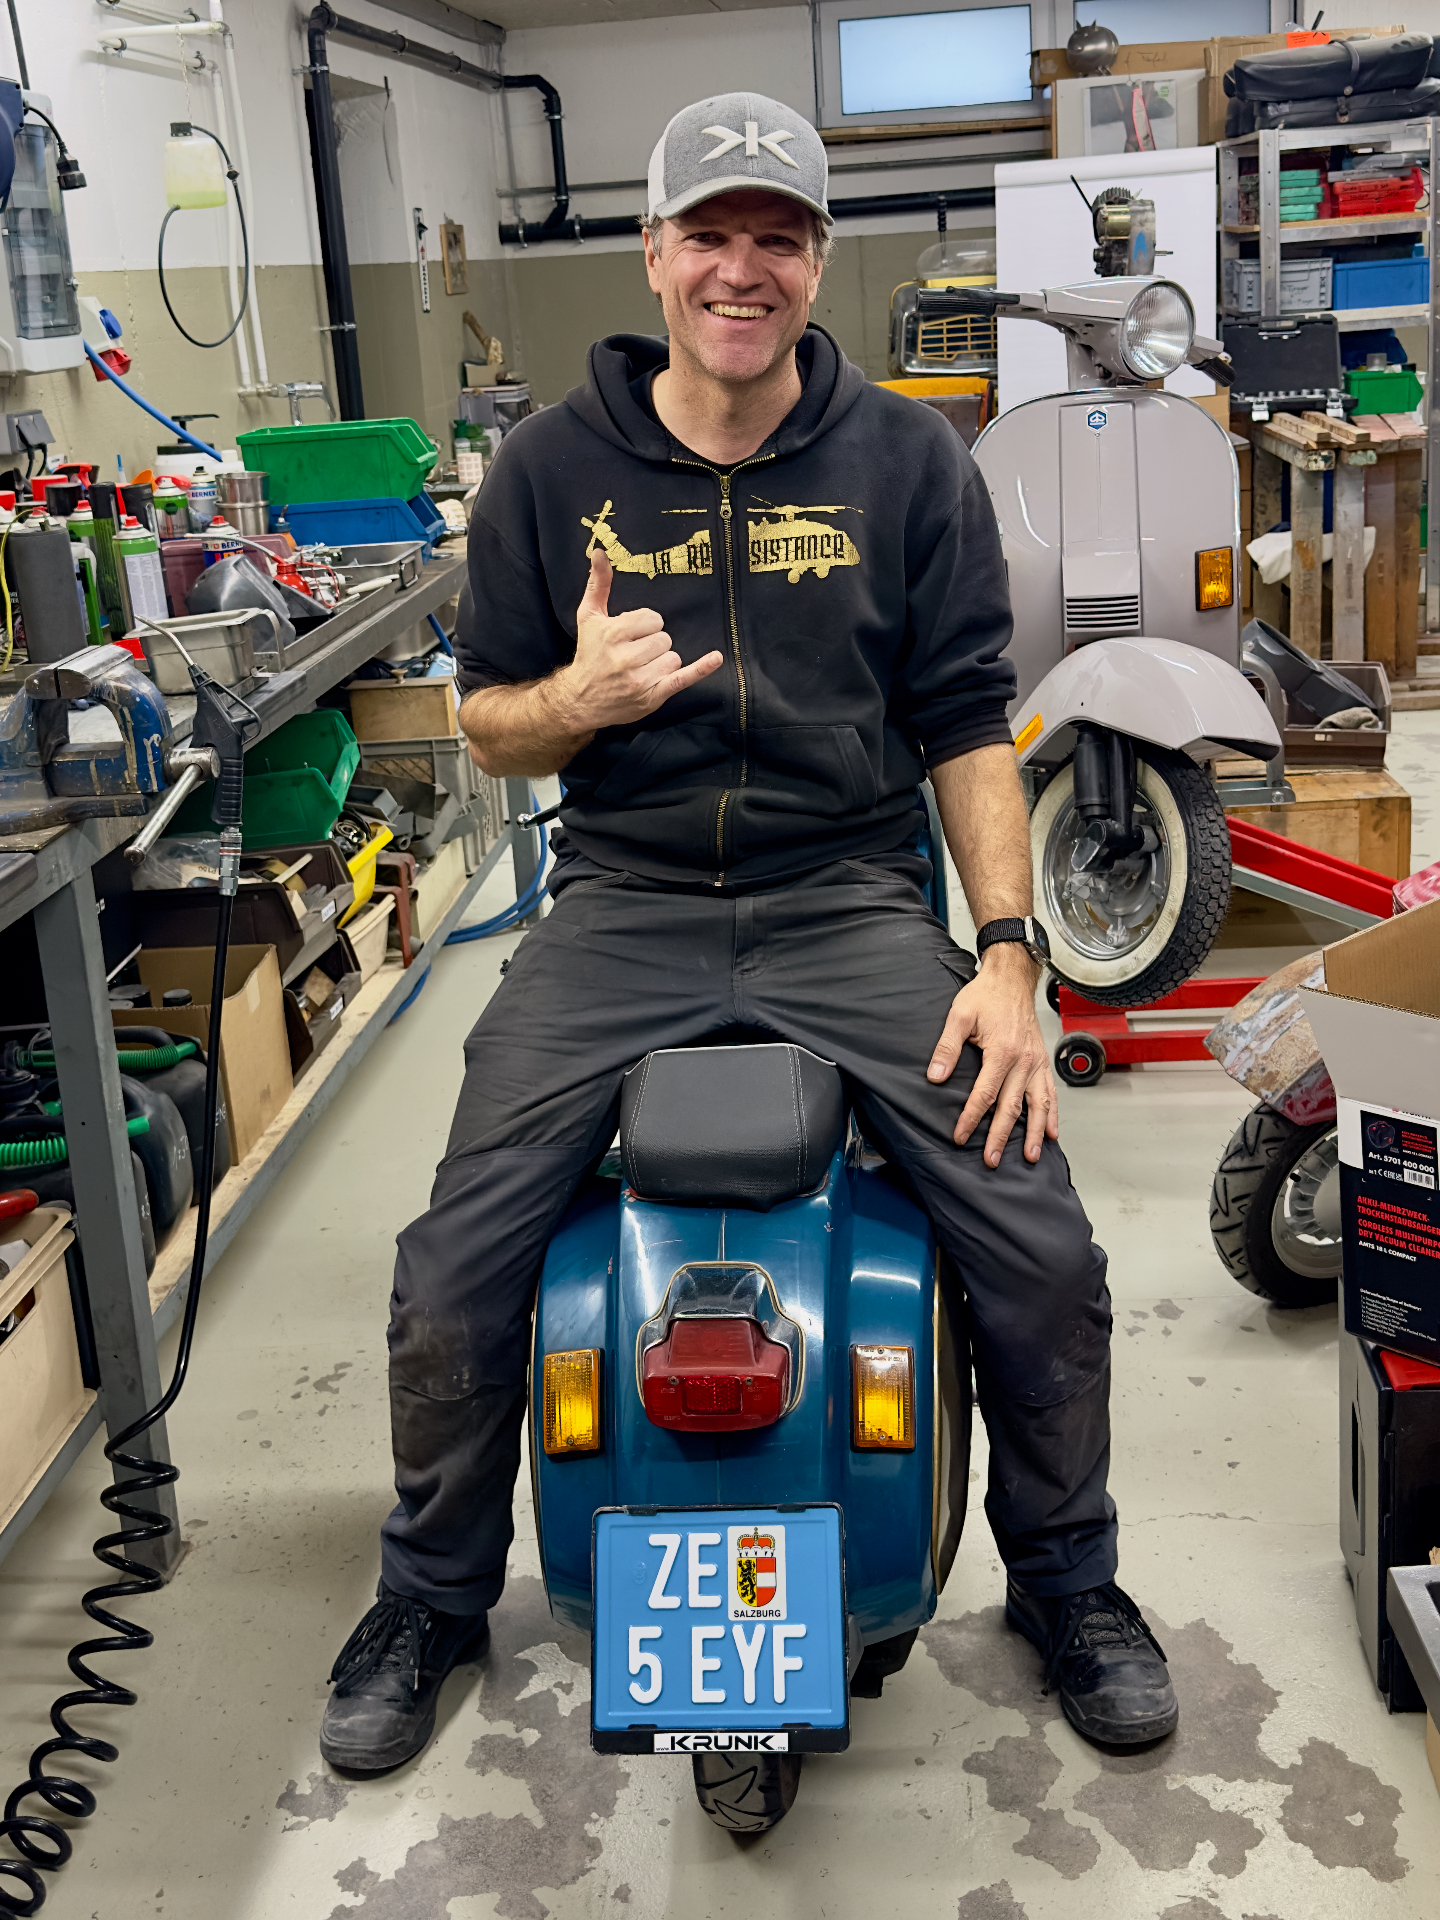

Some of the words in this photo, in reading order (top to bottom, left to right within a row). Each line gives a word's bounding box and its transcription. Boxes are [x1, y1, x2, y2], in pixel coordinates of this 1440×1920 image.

[191, 490, 216, 498] BERNER
[1368, 1152, 1383, 1161] Art.
[1383, 1155, 1401, 1165] 5701
[1402, 1160, 1418, 1170] 400
[1418, 1165, 1435, 1174] 000
[1356, 1195, 1430, 1222] AKKU-MEHRZWECK-
[1356, 1205, 1440, 1236] TROCKENSTAUBSAUGER
[1357, 1218, 1393, 1236] CORDLESS
[1358, 1228, 1373, 1239] DRY
[1375, 1232, 1407, 1249] VACUUM
[1408, 1243, 1440, 1259] CLEANER
[1358, 1240, 1375, 1250] AMTS
[1387, 1249, 1417, 1262] COMPACT
[647, 1532, 722, 1609] ZE
[733, 1609, 781, 1618] SALZBURG
[628, 1625, 663, 1704] 5
[691, 1624, 807, 1704] EYF
[670, 1735, 776, 1750] KRUNK
